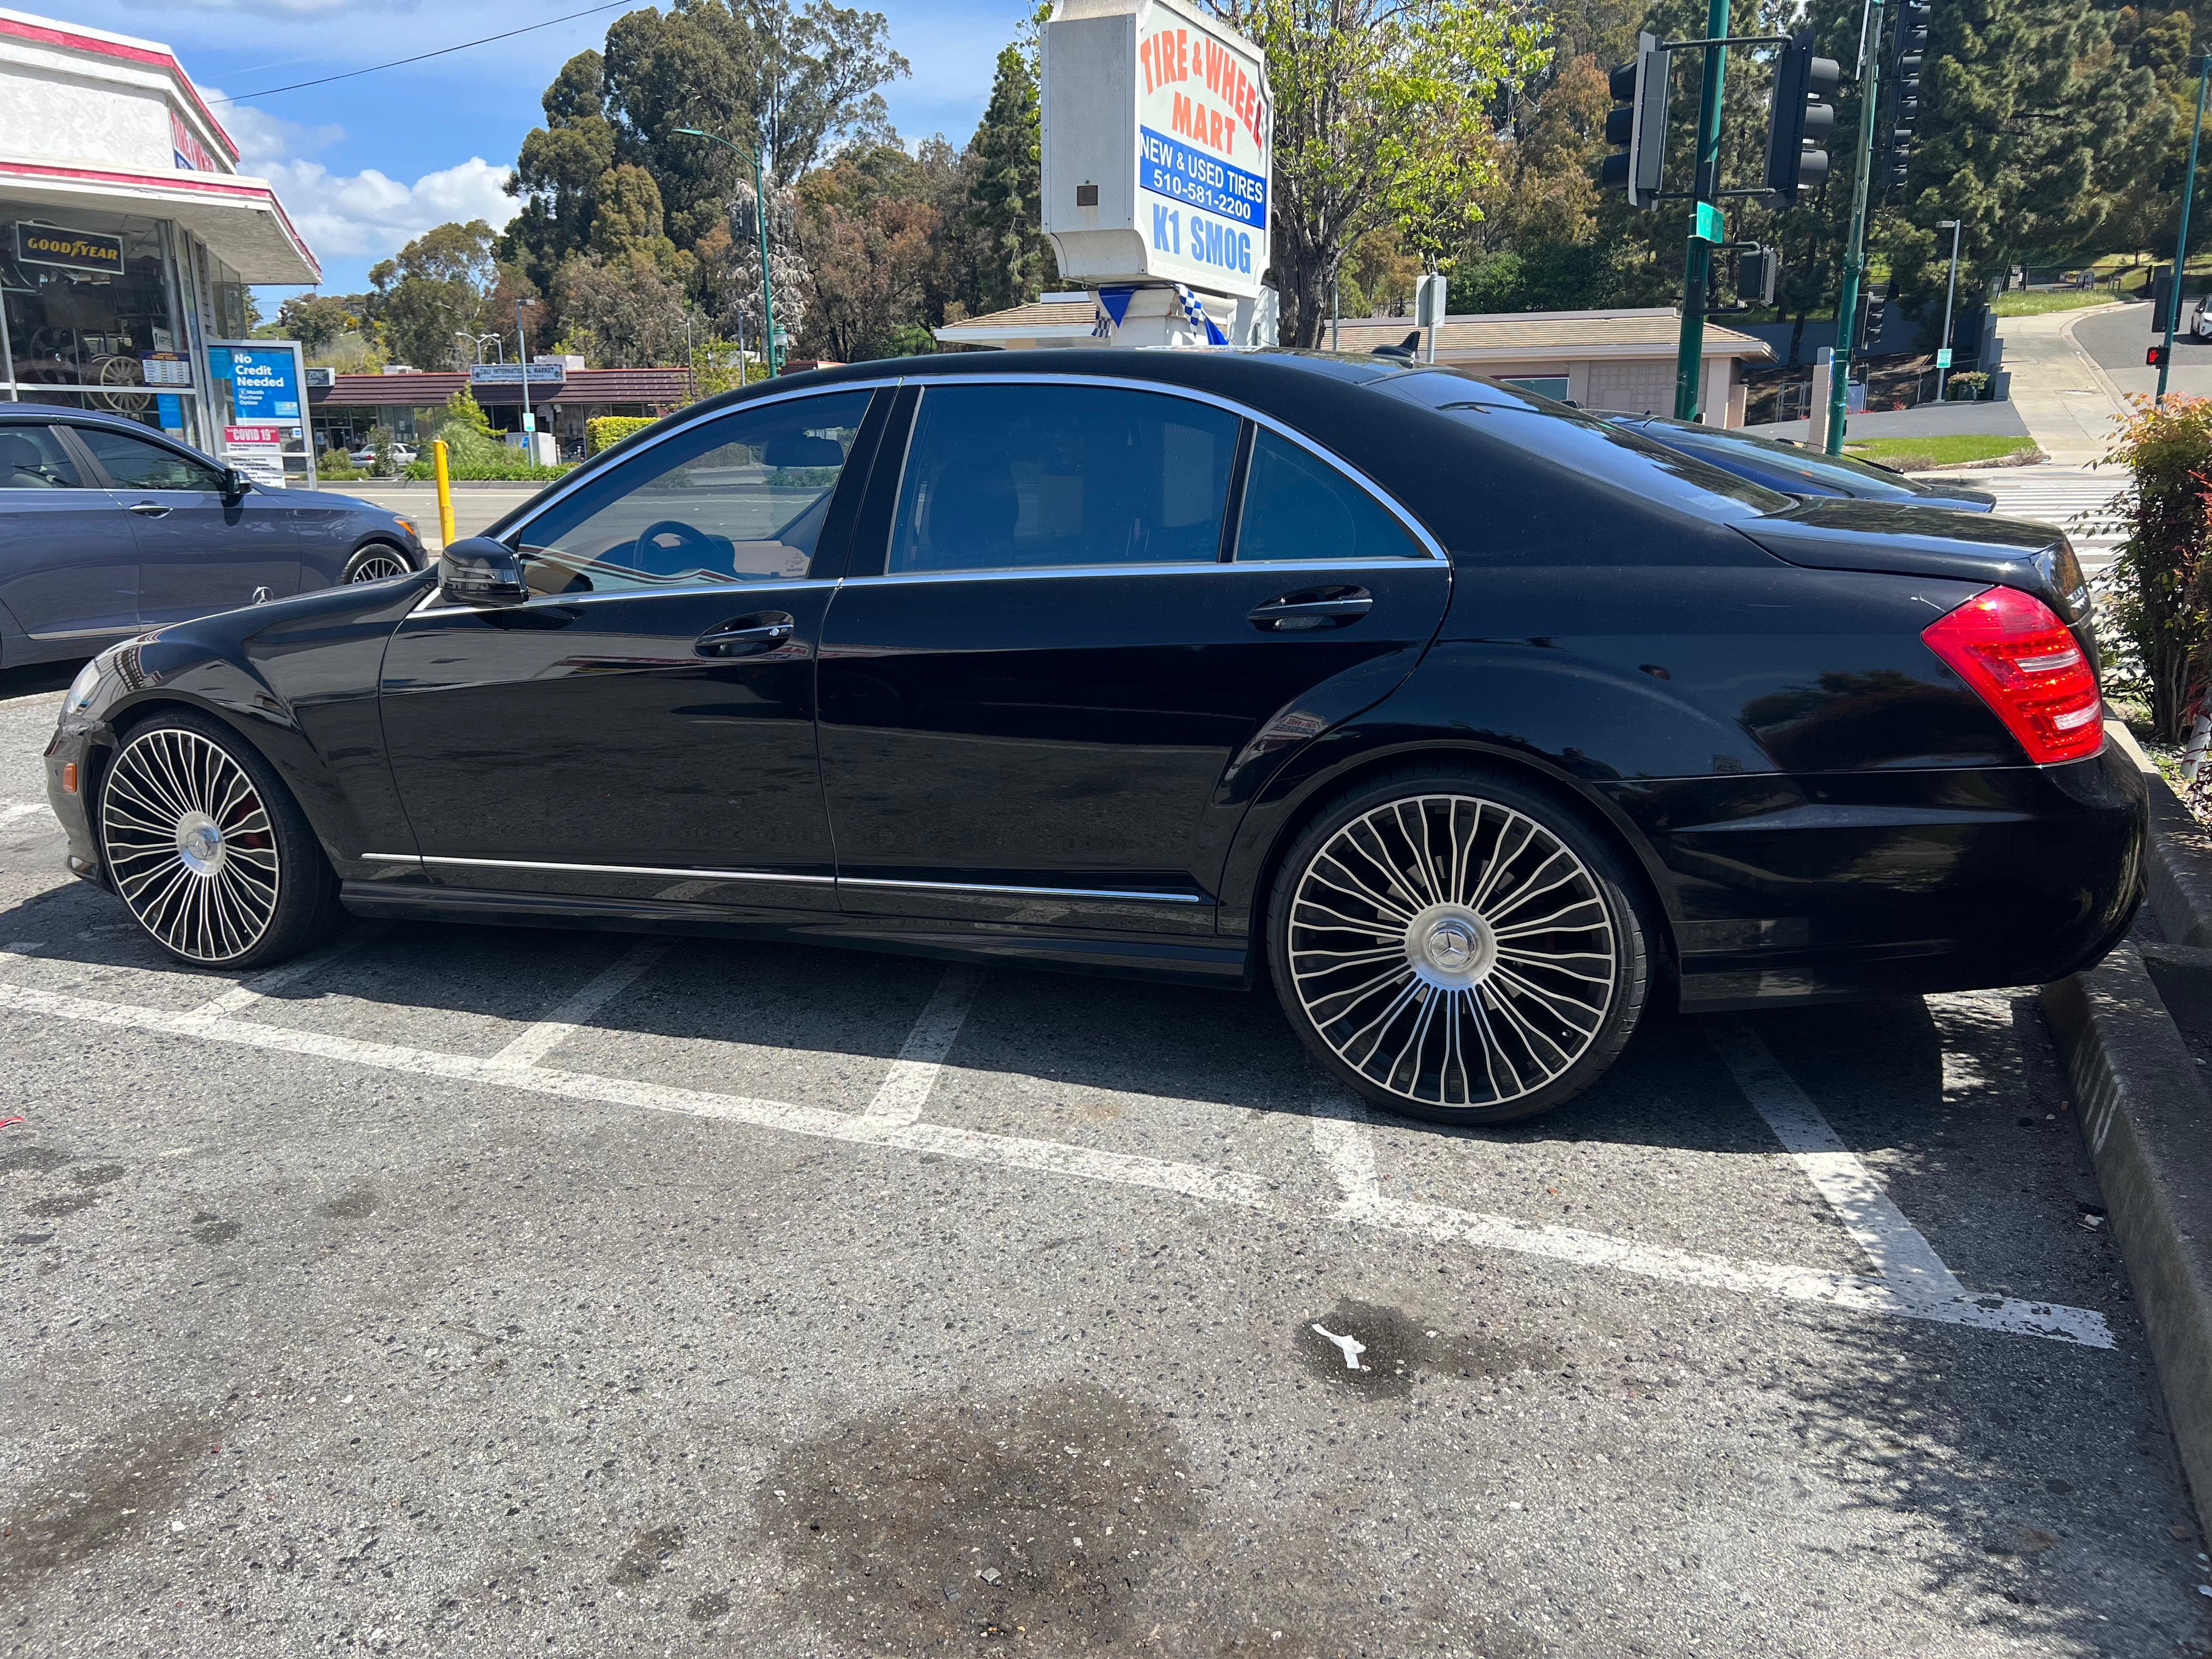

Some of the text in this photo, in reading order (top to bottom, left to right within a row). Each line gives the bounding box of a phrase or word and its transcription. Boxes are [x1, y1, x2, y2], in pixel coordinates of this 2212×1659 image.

[1140, 29, 1263, 151] TIRE & WHEEL
[1171, 91, 1236, 156] MART
[1140, 133, 1263, 204] NEW & USED TIRES
[1153, 168, 1251, 220] 510-581-2200
[1153, 202, 1251, 274] K1 SMOG
[234, 354, 252, 364] No
[235, 365, 273, 376] Credit
[236, 376, 284, 387] Needed
